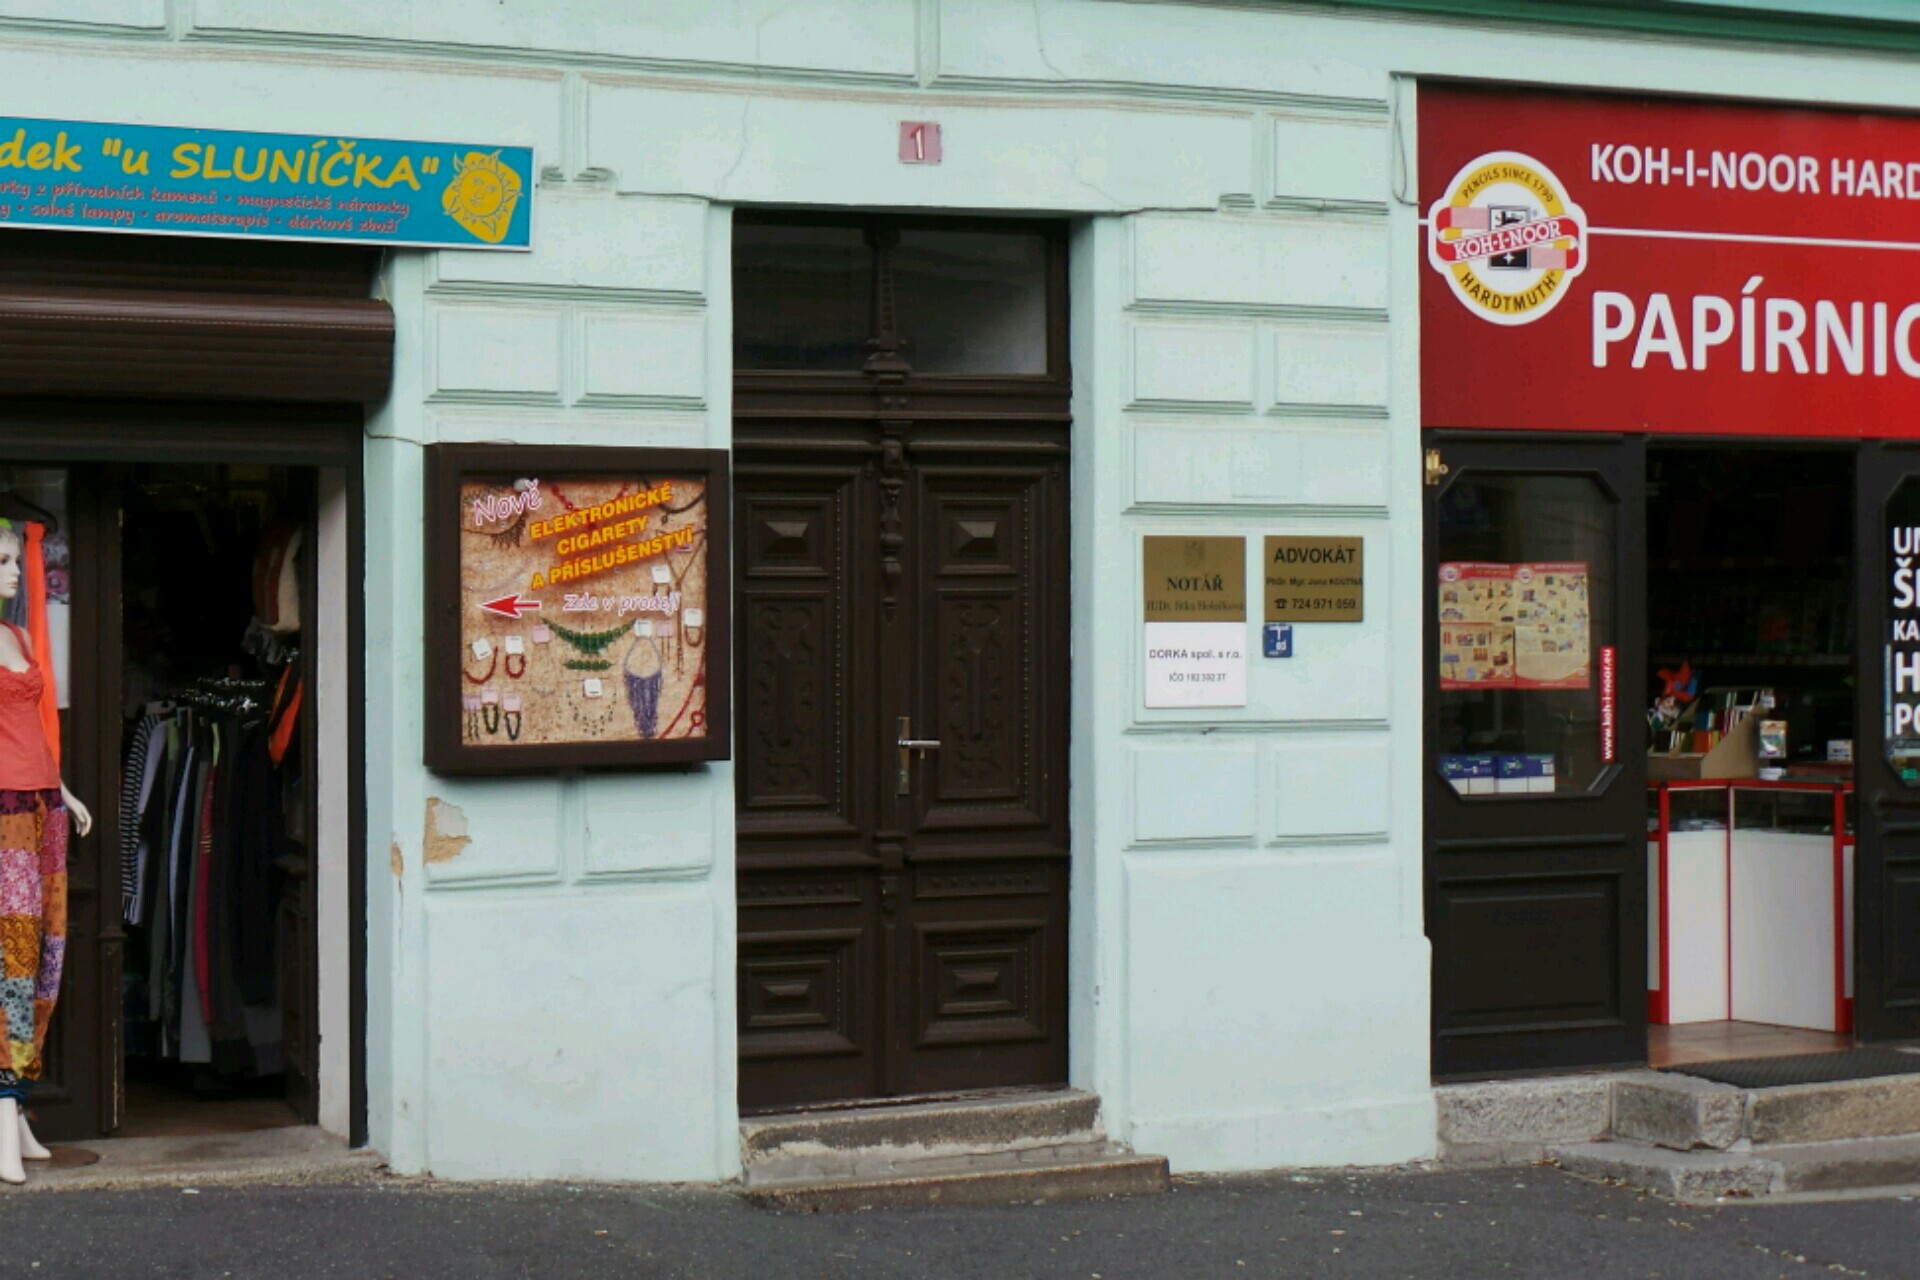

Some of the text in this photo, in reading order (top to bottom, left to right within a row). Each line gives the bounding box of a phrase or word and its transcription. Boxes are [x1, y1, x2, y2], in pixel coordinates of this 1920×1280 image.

[0, 128, 440, 191] dek "u SLUNÍČKA"
[909, 125, 925, 160] 1
[1461, 167, 1500, 199] PENCILS
[1502, 167, 1531, 183] SINCE
[1591, 143, 1820, 195] KOH-I-NOOR
[30, 202, 74, 218] solné
[80, 202, 134, 226] lampy
[155, 210, 269, 232] aromaterapie
[287, 213, 353, 231] dárkové
[51, 178, 145, 204] přírodních
[237, 193, 331, 212] magnetické
[337, 195, 409, 219] náramky
[1454, 221, 1561, 261] KOH-I-NOOR
[1460, 272, 1556, 311] HARDTMUTH
[530, 484, 672, 539] ELEKTRONICKÉ
[556, 515, 648, 555] CIGARETY
[1274, 545, 1356, 564] ADVOKÁT
[531, 525, 694, 591] A PŘÍSLUŠENSTVÍ
[1166, 574, 1224, 592] NOTÁŘ
[602, 595, 616, 611] v
[1291, 598, 1311, 609] 724
[1313, 598, 1333, 609] 971
[1601, 648, 1613, 760] www.koh-i-noor.eu
